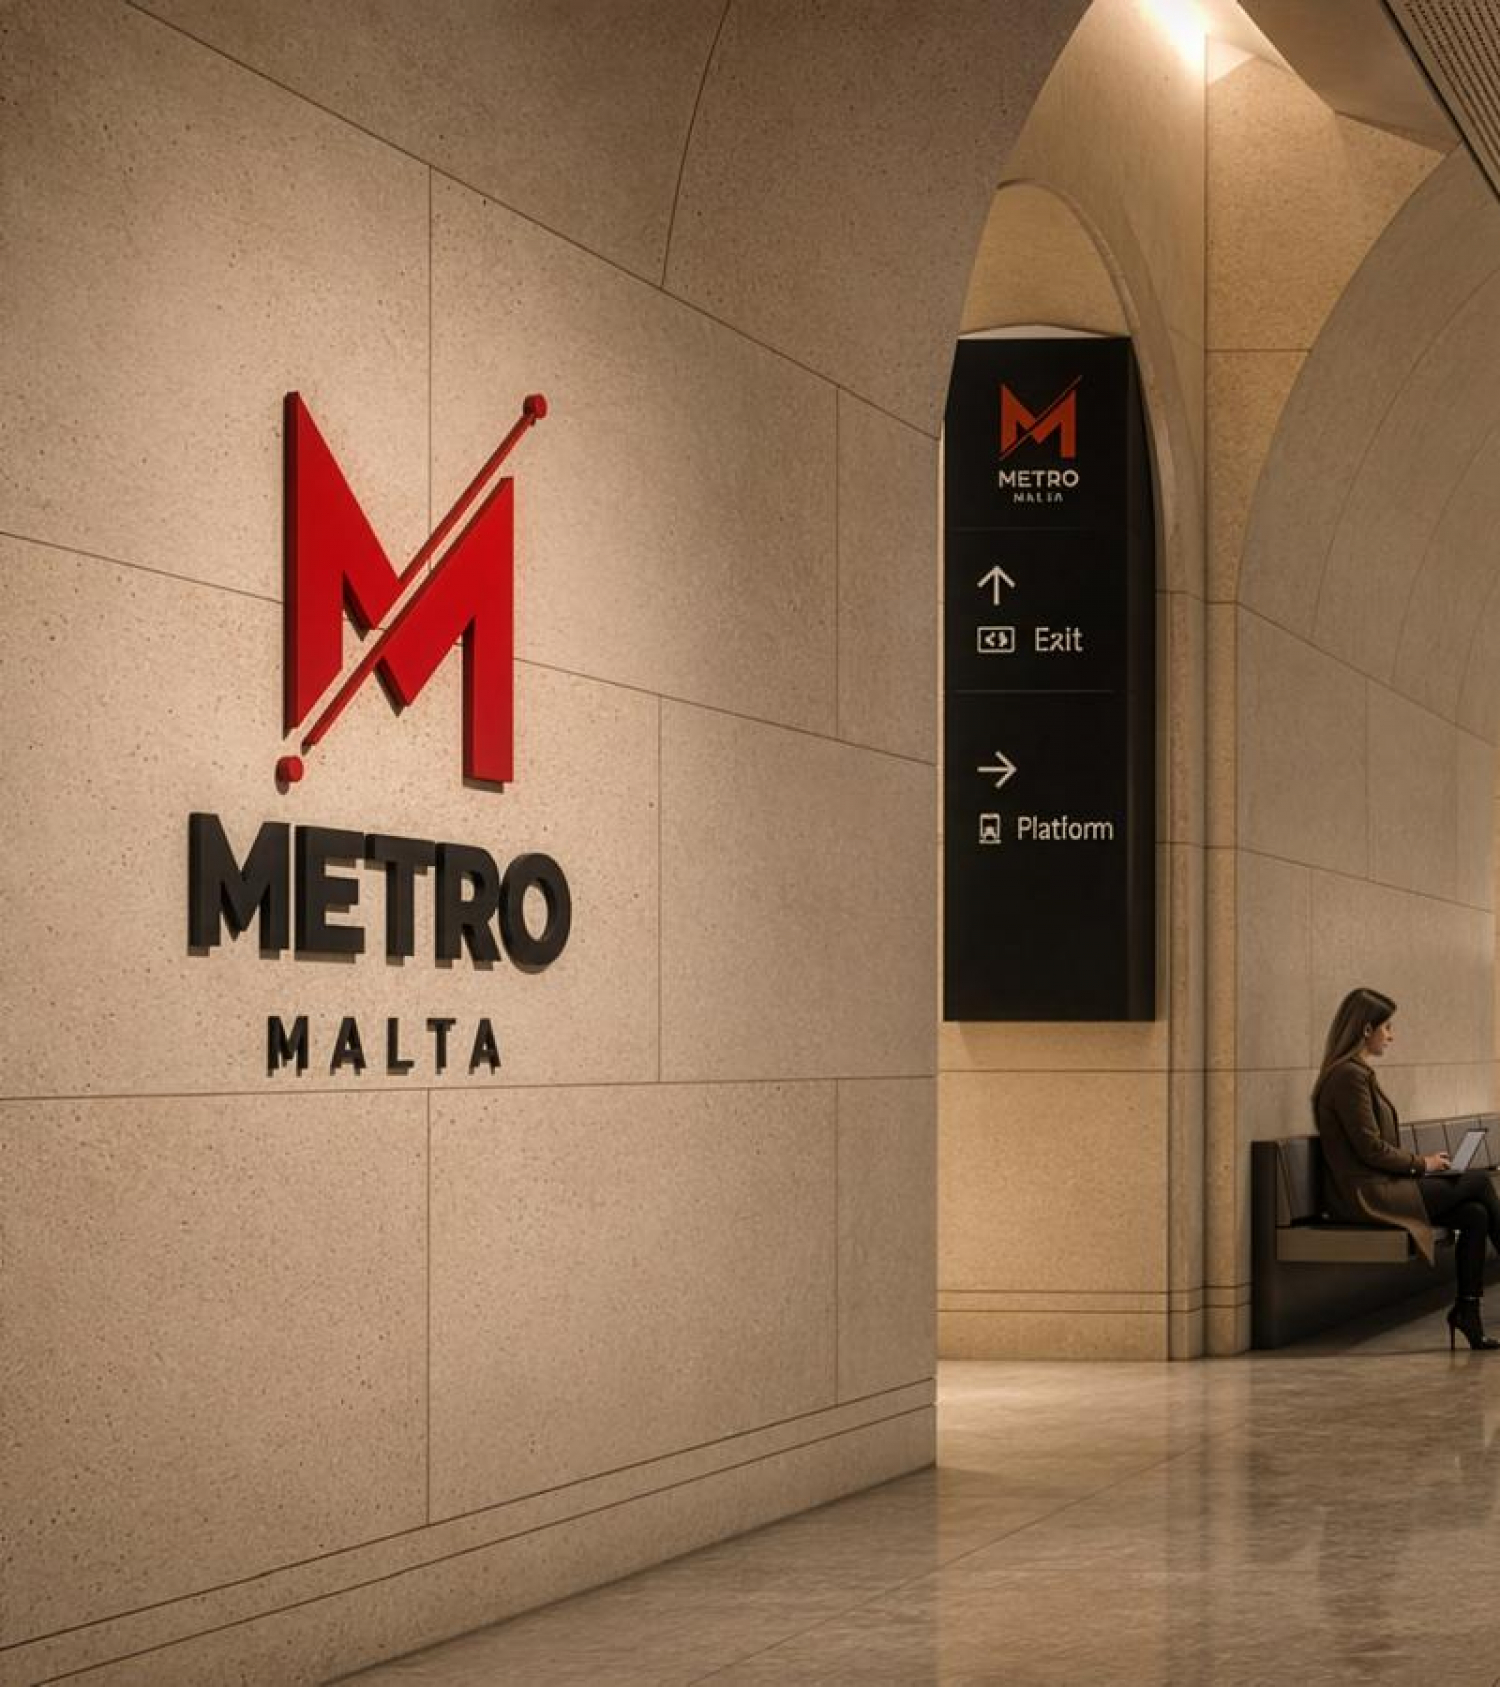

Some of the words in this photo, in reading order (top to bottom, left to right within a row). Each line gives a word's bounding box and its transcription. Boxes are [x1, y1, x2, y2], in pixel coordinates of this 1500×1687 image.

[998, 469, 1079, 488] METRO
[1034, 627, 1083, 652] Exit
[1017, 815, 1114, 842] Platform
[187, 811, 571, 973] METRO
[266, 1015, 501, 1077] MALTA
